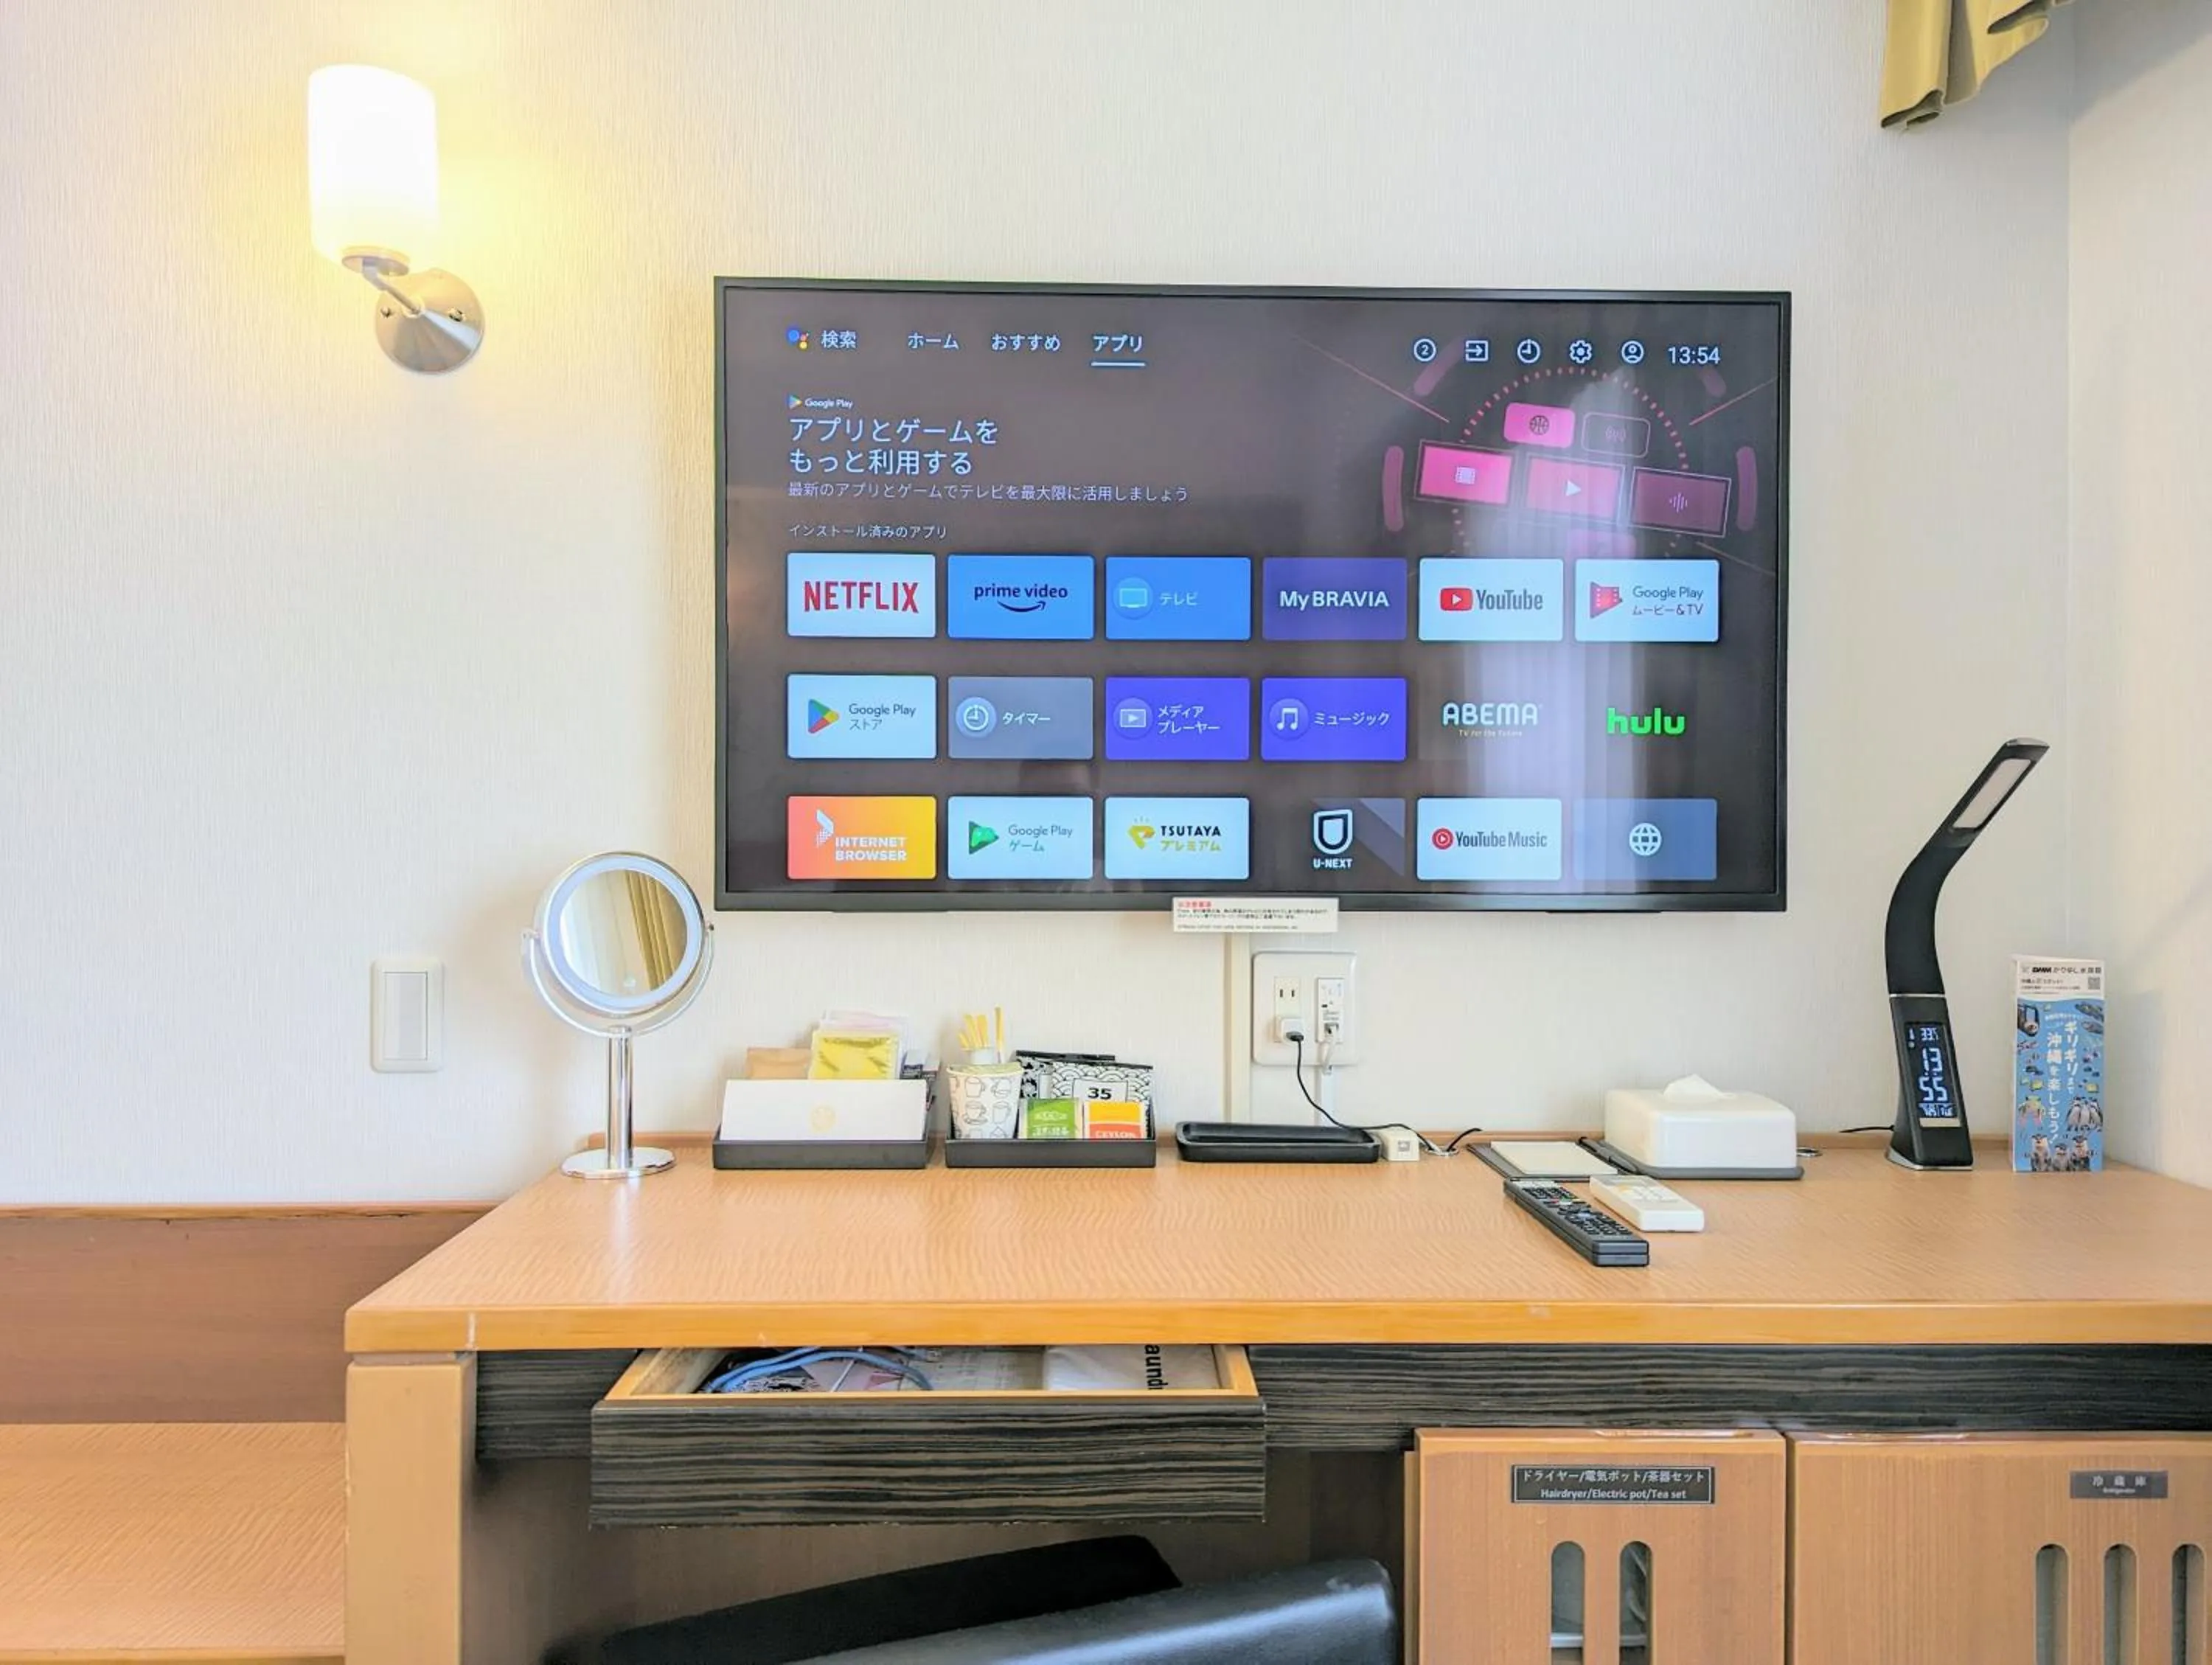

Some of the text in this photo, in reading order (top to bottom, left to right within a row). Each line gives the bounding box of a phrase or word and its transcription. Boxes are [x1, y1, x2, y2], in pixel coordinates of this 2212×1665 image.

[821, 330, 857, 349] 検索
[908, 332, 959, 350] ホーム
[991, 333, 1061, 352] おすすめ
[1093, 335, 1143, 352] アプリ
[1668, 346, 1721, 365] 13:54
[804, 397, 853, 410] Google Play
[790, 417, 998, 445] アプリとゲームを
[790, 448, 973, 476] もっと利用する
[788, 482, 1187, 503] 最新のアプリとゲームでテレビを最大限に活用しましょう
[789, 524, 947, 538] インストール済みのアプリ
[804, 580, 919, 613] NETFLIX
[973, 583, 1068, 601] prime video
[1159, 592, 1198, 606] テレビ
[1632, 586, 1704, 600] Google Play
[1279, 591, 1389, 611] My BRAVIA
[1476, 589, 1543, 611] YouTube
[1632, 604, 1703, 616] ムービー&TV
[849, 703, 917, 717] Google Play
[1157, 705, 1204, 718] メディア
[1442, 702, 1539, 726] ABEMA
[849, 718, 883, 731] ストア
[1002, 713, 1051, 726] タイマー
[1314, 712, 1391, 726] ミュージック
[1607, 707, 1686, 736] hulu
[1157, 721, 1220, 734] プレーヤー
[1008, 825, 1073, 838] Google Play
[1161, 825, 1221, 837] TSUTAYA
[835, 837, 906, 848] INTERNET
[1009, 840, 1045, 852] ゲーム
[1161, 840, 1221, 852] プレミアム
[1455, 831, 1547, 847] YouTube Music
[835, 850, 907, 861] BROWSER
[1313, 858, 1353, 869] U-NEXT
[1088, 1087, 1112, 1099] 35
[1671, 1490, 1686, 1499] set
